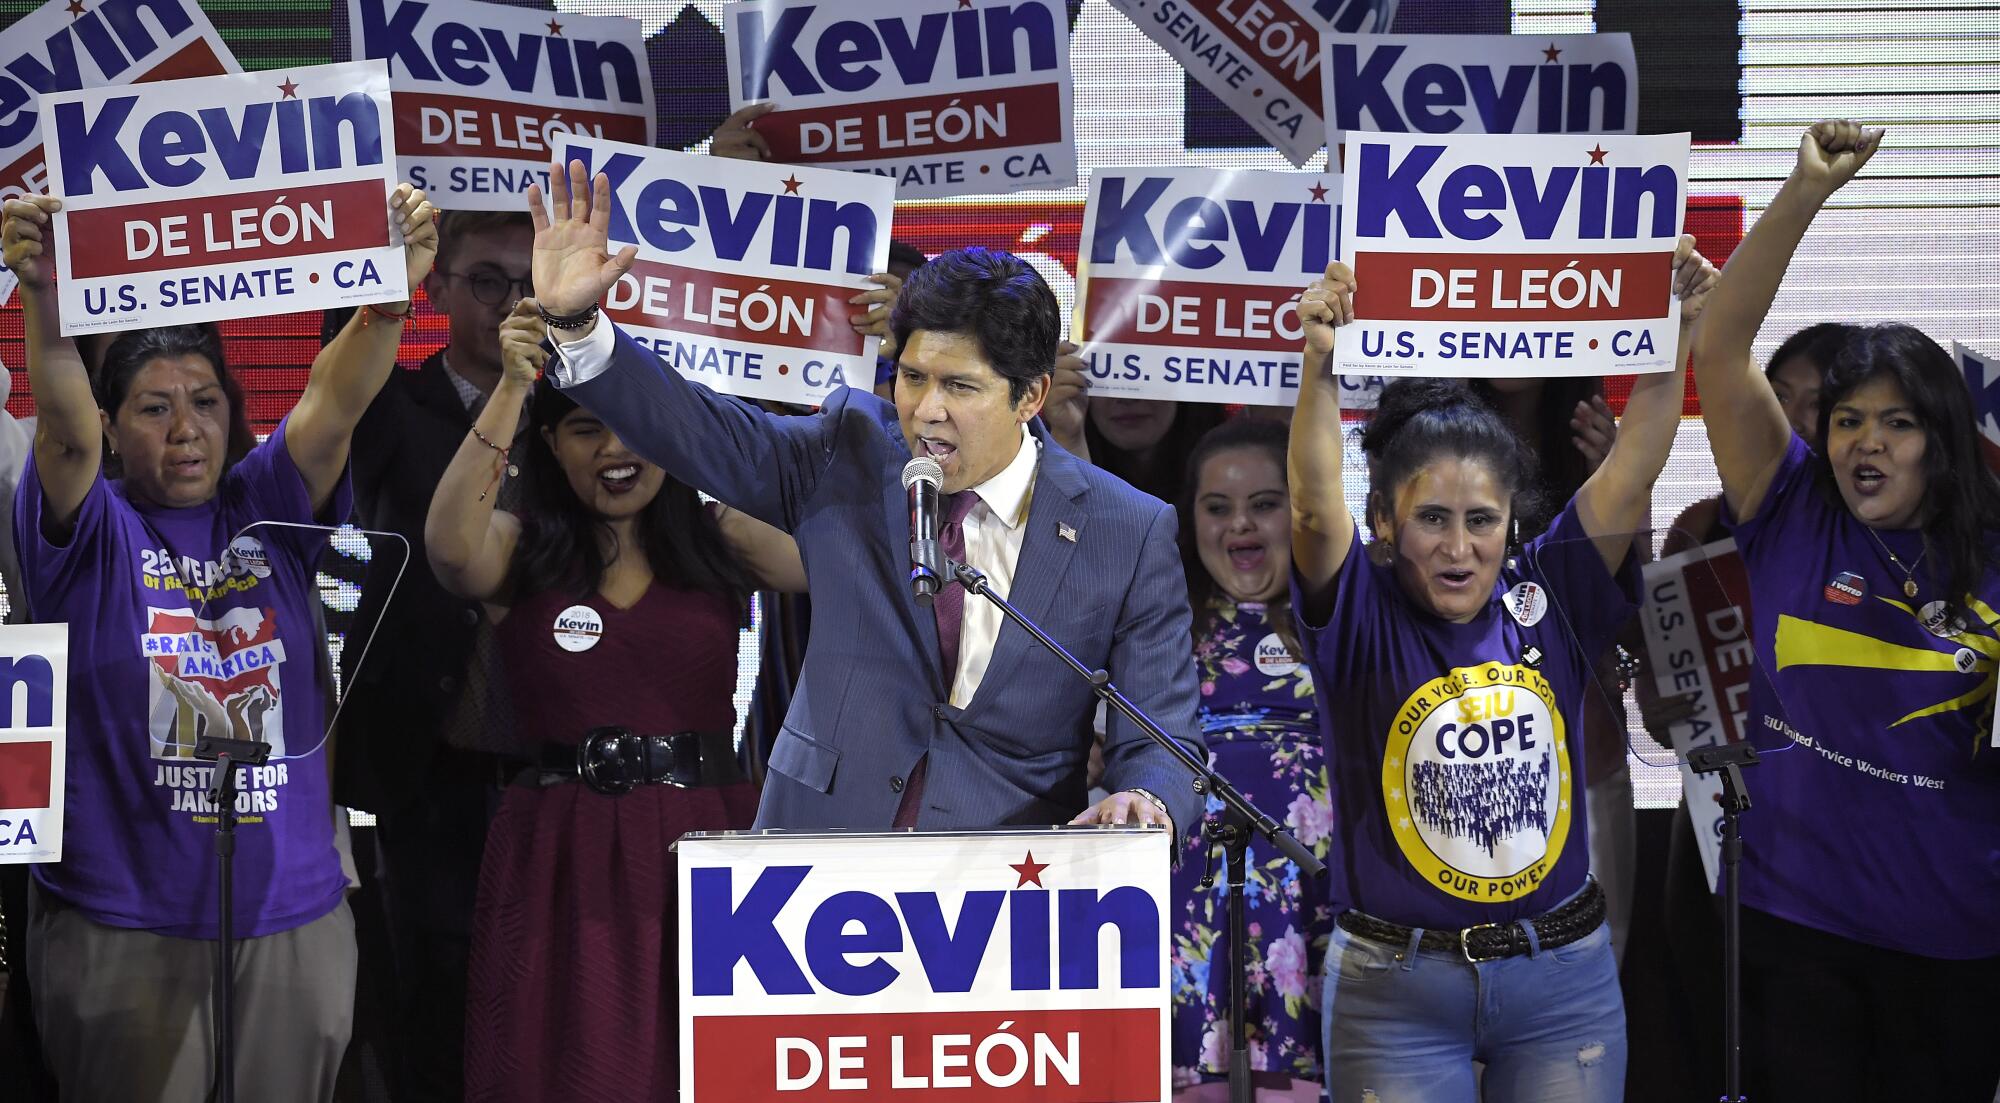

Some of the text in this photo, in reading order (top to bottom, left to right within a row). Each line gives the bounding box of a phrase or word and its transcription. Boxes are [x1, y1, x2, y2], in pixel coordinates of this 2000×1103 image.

[360, 0, 643, 104] Kevin
[737, 0, 1058, 100] Kevin
[1153, 0, 1253, 89] SENATE
[1332, 44, 1627, 134] Kevin
[421, 107, 482, 146] DE
[800, 100, 1007, 155] DE LEÓN
[1265, 99, 1304, 139] CA
[54, 92, 384, 197] Kevin
[1003, 153, 1052, 178] CA
[449, 167, 553, 194] SENAT
[1355, 143, 1678, 241] Kevin
[124, 195, 335, 261] DE LEÓN
[565, 144, 878, 275] Kevin
[1090, 177, 1342, 274] Kevi
[84, 258, 383, 316] U.S. SENATE CA
[606, 273, 815, 337] DE LEÓN
[1410, 260, 1622, 310] DE LEÓN
[1136, 288, 1305, 341] DE LEÓ
[634, 336, 847, 389] ENATE CA
[1361, 329, 1655, 359] U.S. SENATE CA
[1090, 352, 1150, 381] U.S.
[1163, 357, 1300, 389] SENATE
[141, 549, 232, 587] 25 YEA
[143, 574, 159, 590] Of
[1837, 582, 1863, 597] VOTED
[558, 618, 600, 631] Kevin
[1653, 580, 1684, 641] U.S.
[146, 634, 212, 654] #RAI
[184, 646, 277, 679] AMRICA
[1259, 645, 1286, 655] Kev
[1706, 605, 1754, 673] DE
[1399, 697, 1432, 735] OUR
[1487, 668, 1525, 683] OUR
[1457, 689, 1515, 724] SEIU
[1435, 713, 1536, 758] COPE
[154, 763, 288, 789] JUSTE FOR
[1856, 759, 1909, 784] Workers
[1912, 775, 1945, 790] West
[170, 789, 278, 814] JANORS
[1438, 869, 1479, 896] OUR
[691, 865, 1160, 996] Kevin
[775, 1020, 1081, 1091] DE LEÓN
